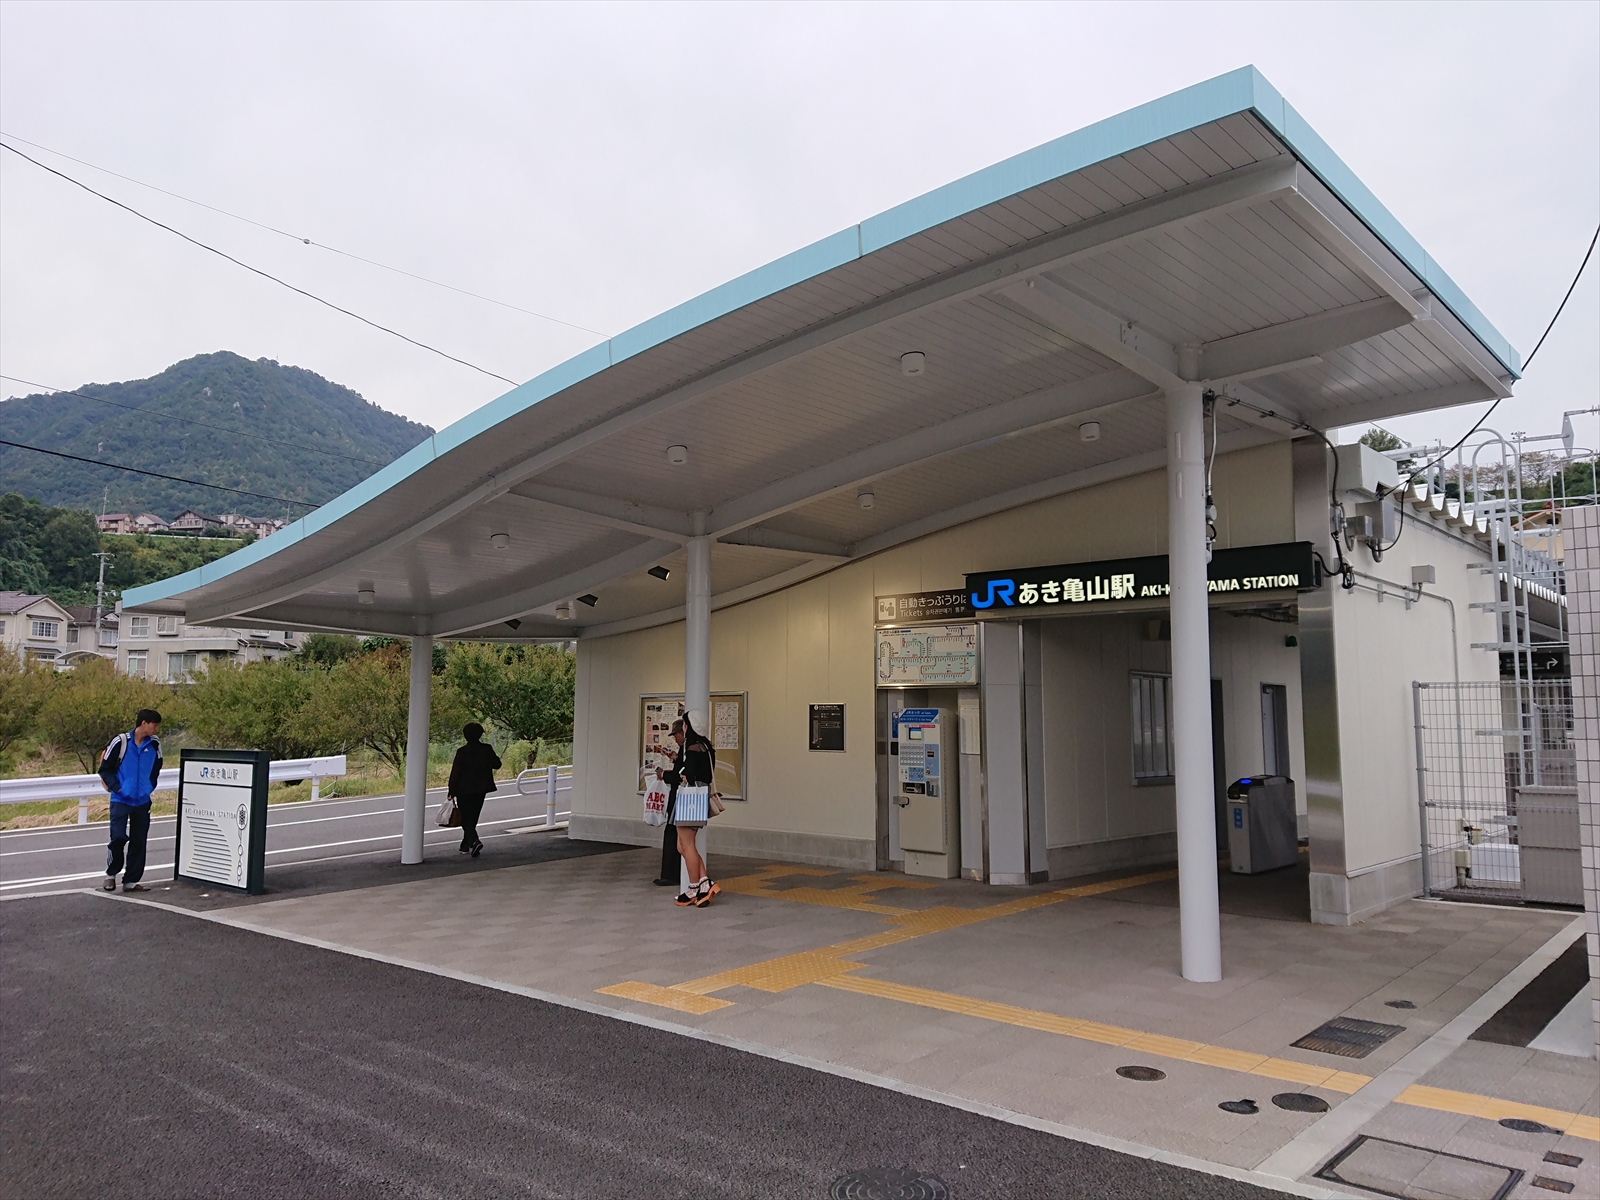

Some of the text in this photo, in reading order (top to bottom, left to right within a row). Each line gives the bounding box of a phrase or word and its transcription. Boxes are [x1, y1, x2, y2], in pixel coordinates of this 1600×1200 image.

[971, 573, 1299, 609] JR あき亀山駅 AKI-KAMA STATION
[900, 609, 923, 618] Tickets
[200, 767, 209, 778] JR
[647, 792, 665, 803] ABC
[646, 803, 664, 811] MART
